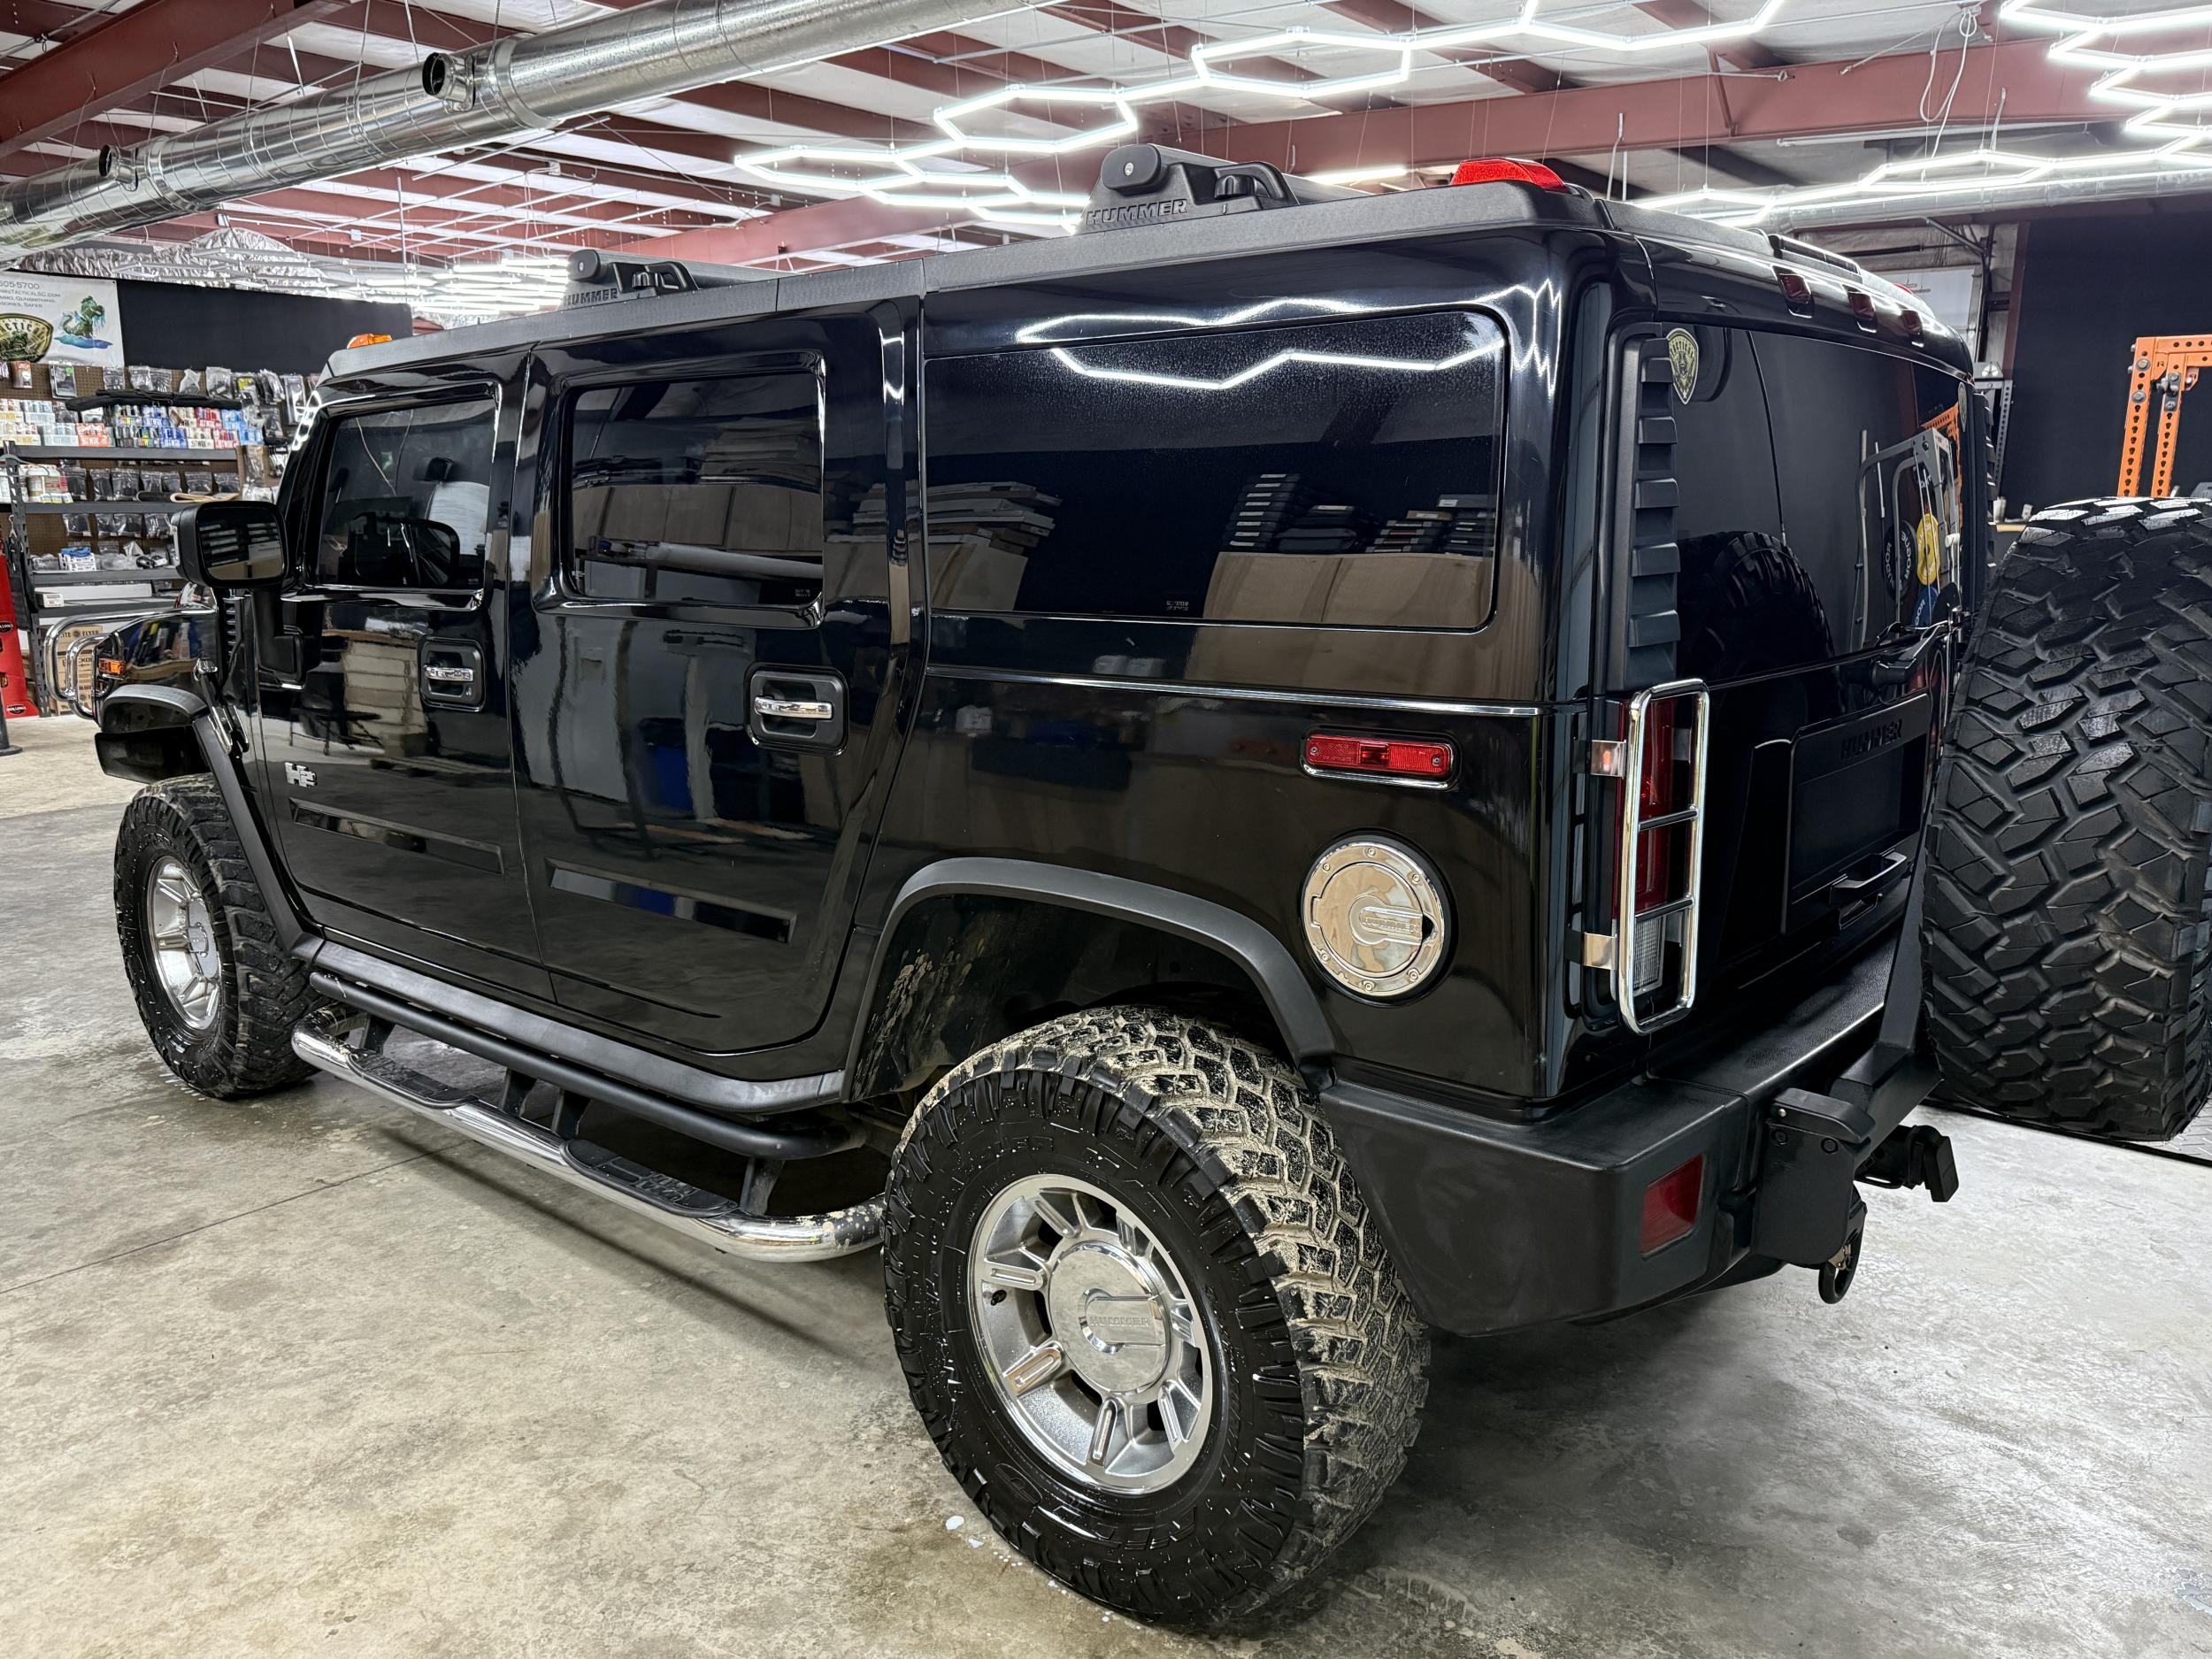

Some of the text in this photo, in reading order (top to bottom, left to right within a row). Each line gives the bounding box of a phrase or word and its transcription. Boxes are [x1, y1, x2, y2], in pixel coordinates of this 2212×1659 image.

[1086, 198, 1188, 226] HUMMER
[563, 288, 618, 306] HUMMER
[1840, 718, 1902, 760] HUMMER
[1088, 1316, 1149, 1327] HUMMER
